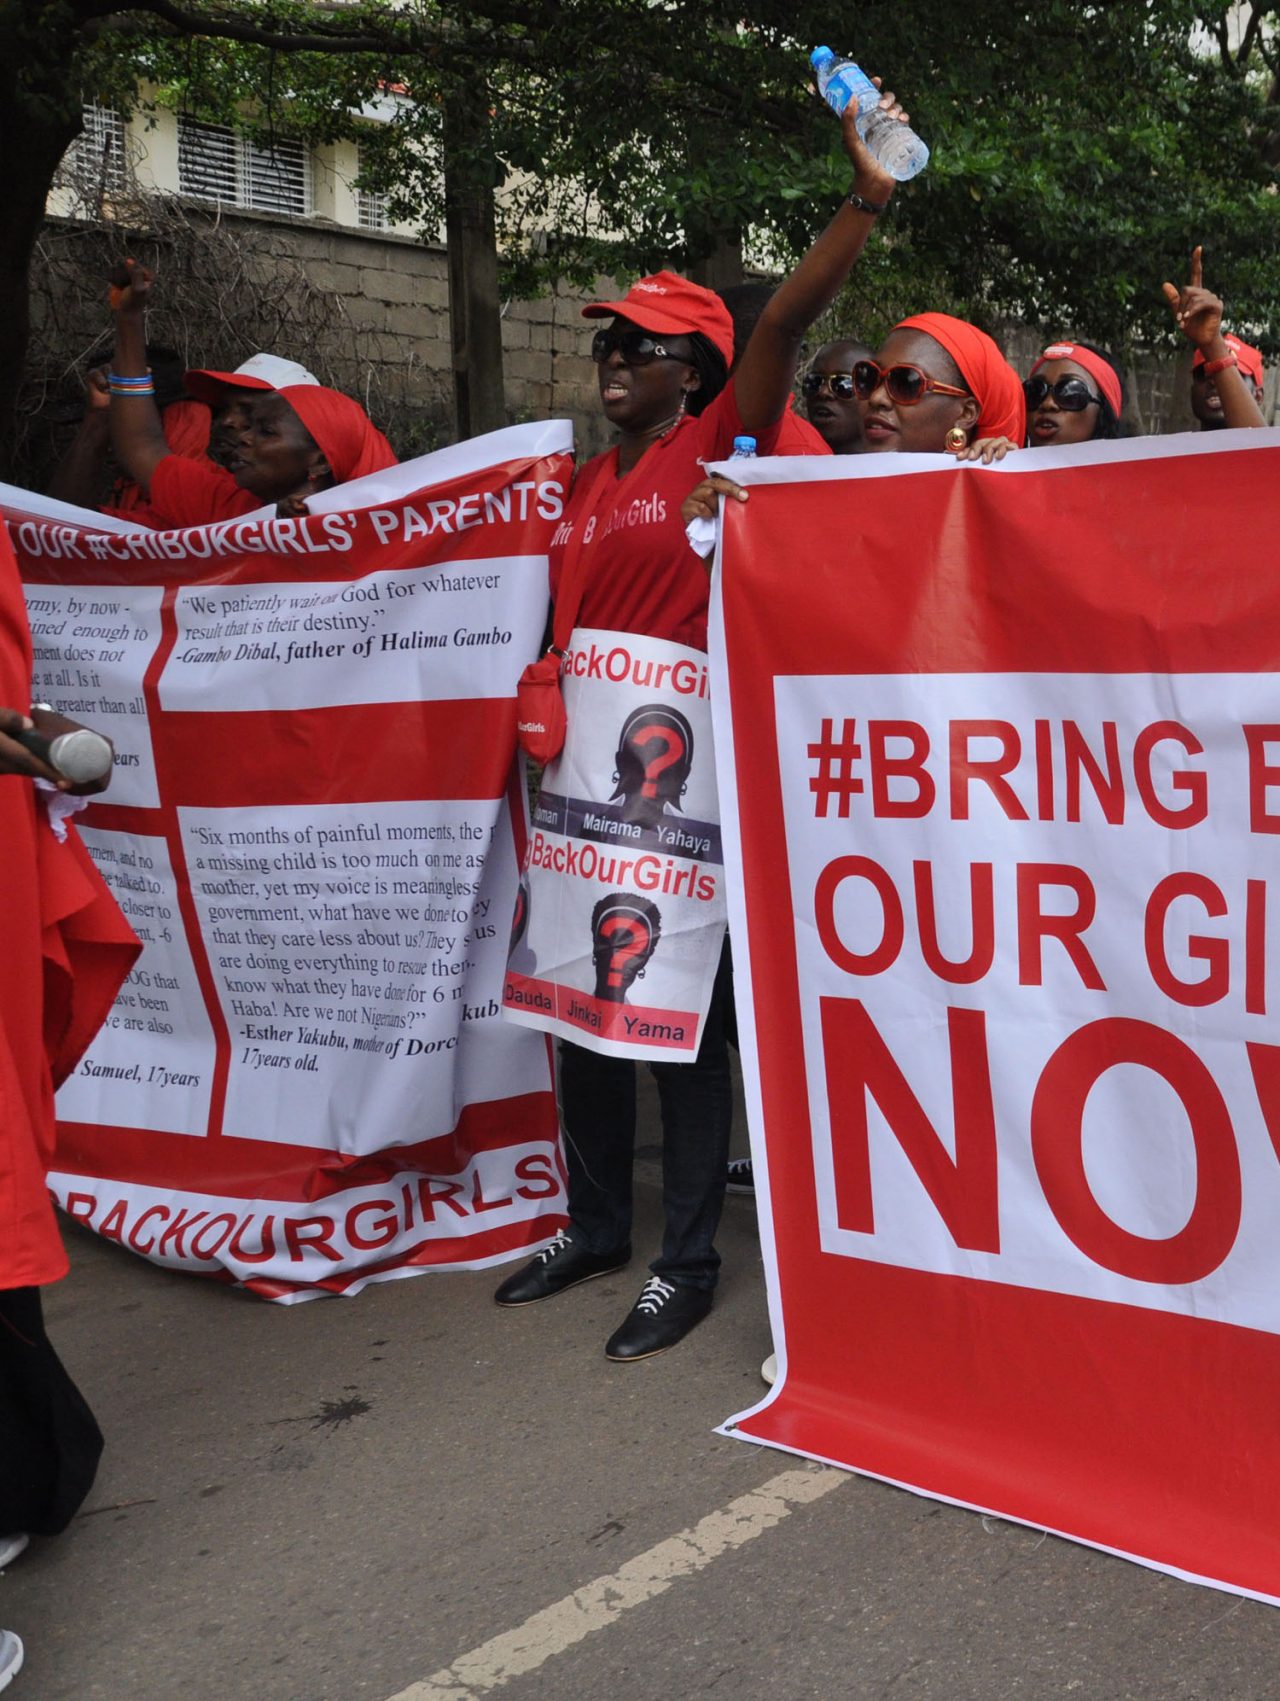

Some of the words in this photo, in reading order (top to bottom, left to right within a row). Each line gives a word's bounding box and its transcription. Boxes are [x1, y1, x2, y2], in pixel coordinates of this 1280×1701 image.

[19, 522, 87, 559] OUR
[369, 480, 564, 544] PARENTS
[26, 599, 61, 615] rmy.
[67, 597, 87, 617] by
[89, 602, 120, 615] now
[221, 594, 286, 617] patiently
[289, 593, 320, 609] wait
[341, 583, 380, 603] God
[386, 581, 416, 599] for
[422, 574, 501, 592] whatever
[72, 624, 129, 644] enough
[133, 627, 148, 641] to
[185, 622, 222, 640] result
[224, 620, 249, 636] that
[251, 615, 263, 634] is
[267, 615, 300, 632] their
[64, 644, 95, 661] does
[98, 650, 126, 662] not
[176, 646, 232, 663] -Gambo
[234, 642, 281, 661] Dibal,
[284, 641, 347, 664] father
[352, 635, 376, 658] of
[381, 631, 448, 651] Halima
[453, 626, 512, 647] Gambo
[43, 672, 54, 686] at
[56, 669, 75, 687] all.
[76, 670, 89, 687] Is
[90, 669, 102, 687] it
[562, 644, 710, 700] ackOurGi
[56, 700, 96, 712] greater
[99, 696, 126, 714] than
[129, 697, 146, 715] all
[113, 753, 140, 767] ears
[807, 717, 1208, 830] #BRING
[228, 826, 290, 844] months
[294, 825, 313, 844] of
[317, 823, 381, 848] painful
[387, 826, 455, 843] moments,
[459, 821, 483, 841] the
[583, 812, 642, 838] Mairama
[656, 825, 711, 854] Yahaya
[120, 850, 136, 867] and
[138, 856, 153, 869] no
[196, 857, 205, 870] a
[208, 853, 271, 875] missing
[273, 852, 317, 870] child
[321, 851, 337, 869] is
[342, 854, 371, 868] too
[376, 849, 418, 868] much
[425, 854, 440, 867] on
[443, 854, 462, 867] me
[466, 854, 485, 868] as
[115, 872, 146, 892] talked
[148, 879, 165, 894] to.
[201, 879, 259, 897] mother,
[263, 881, 289, 900] yet
[293, 882, 320, 899] my
[326, 877, 370, 895] voice
[375, 876, 388, 895] is
[393, 877, 480, 900] meaningless
[122, 898, 155, 918] closer
[158, 904, 171, 919] to
[208, 905, 304, 924] government,
[308, 903, 347, 921] what
[352, 903, 391, 921] have
[395, 907, 420, 921] we
[424, 904, 448, 922] done
[451, 907, 468, 923] to
[814, 855, 1107, 991] OUR
[212, 928, 242, 944] that
[245, 929, 276, 950] they
[281, 934, 315, 946] care
[319, 929, 352, 946] less
[357, 928, 401, 946] about
[405, 930, 424, 948] us?
[425, 931, 456, 954] They
[218, 956, 241, 968] are
[246, 953, 291, 974] doing
[294, 953, 379, 976] everything
[383, 957, 395, 973] to
[397, 960, 428, 975] rescue
[153, 972, 180, 990] that
[224, 975, 267, 993] know
[271, 978, 311, 994] what
[314, 978, 347, 999] they
[351, 979, 382, 998] have
[384, 982, 406, 1000] done
[406, 984, 427, 1003] for
[432, 986, 445, 1003] 6
[113, 993, 136, 1008] ave
[137, 992, 169, 1012] been
[505, 984, 552, 1010] Dauda
[230, 1000, 278, 1017] Haba!
[283, 1001, 310, 1018] Are
[314, 1006, 334, 1020] we
[337, 1008, 357, 1023] not
[462, 999, 499, 1021] kub
[567, 999, 602, 1028] Jinkai
[124, 1017, 144, 1031] are
[147, 1017, 174, 1035] also
[624, 1016, 684, 1041] Yama
[240, 1024, 293, 1042] -Esther
[297, 1026, 348, 1050] Yakubu,
[352, 1035, 384, 1053] mother
[385, 1037, 403, 1060] of
[405, 1036, 459, 1056] Dorc
[242, 1047, 292, 1069] 17years
[294, 1053, 319, 1072] old.
[80, 1060, 142, 1083] Samuel,
[146, 1066, 200, 1088] 17years
